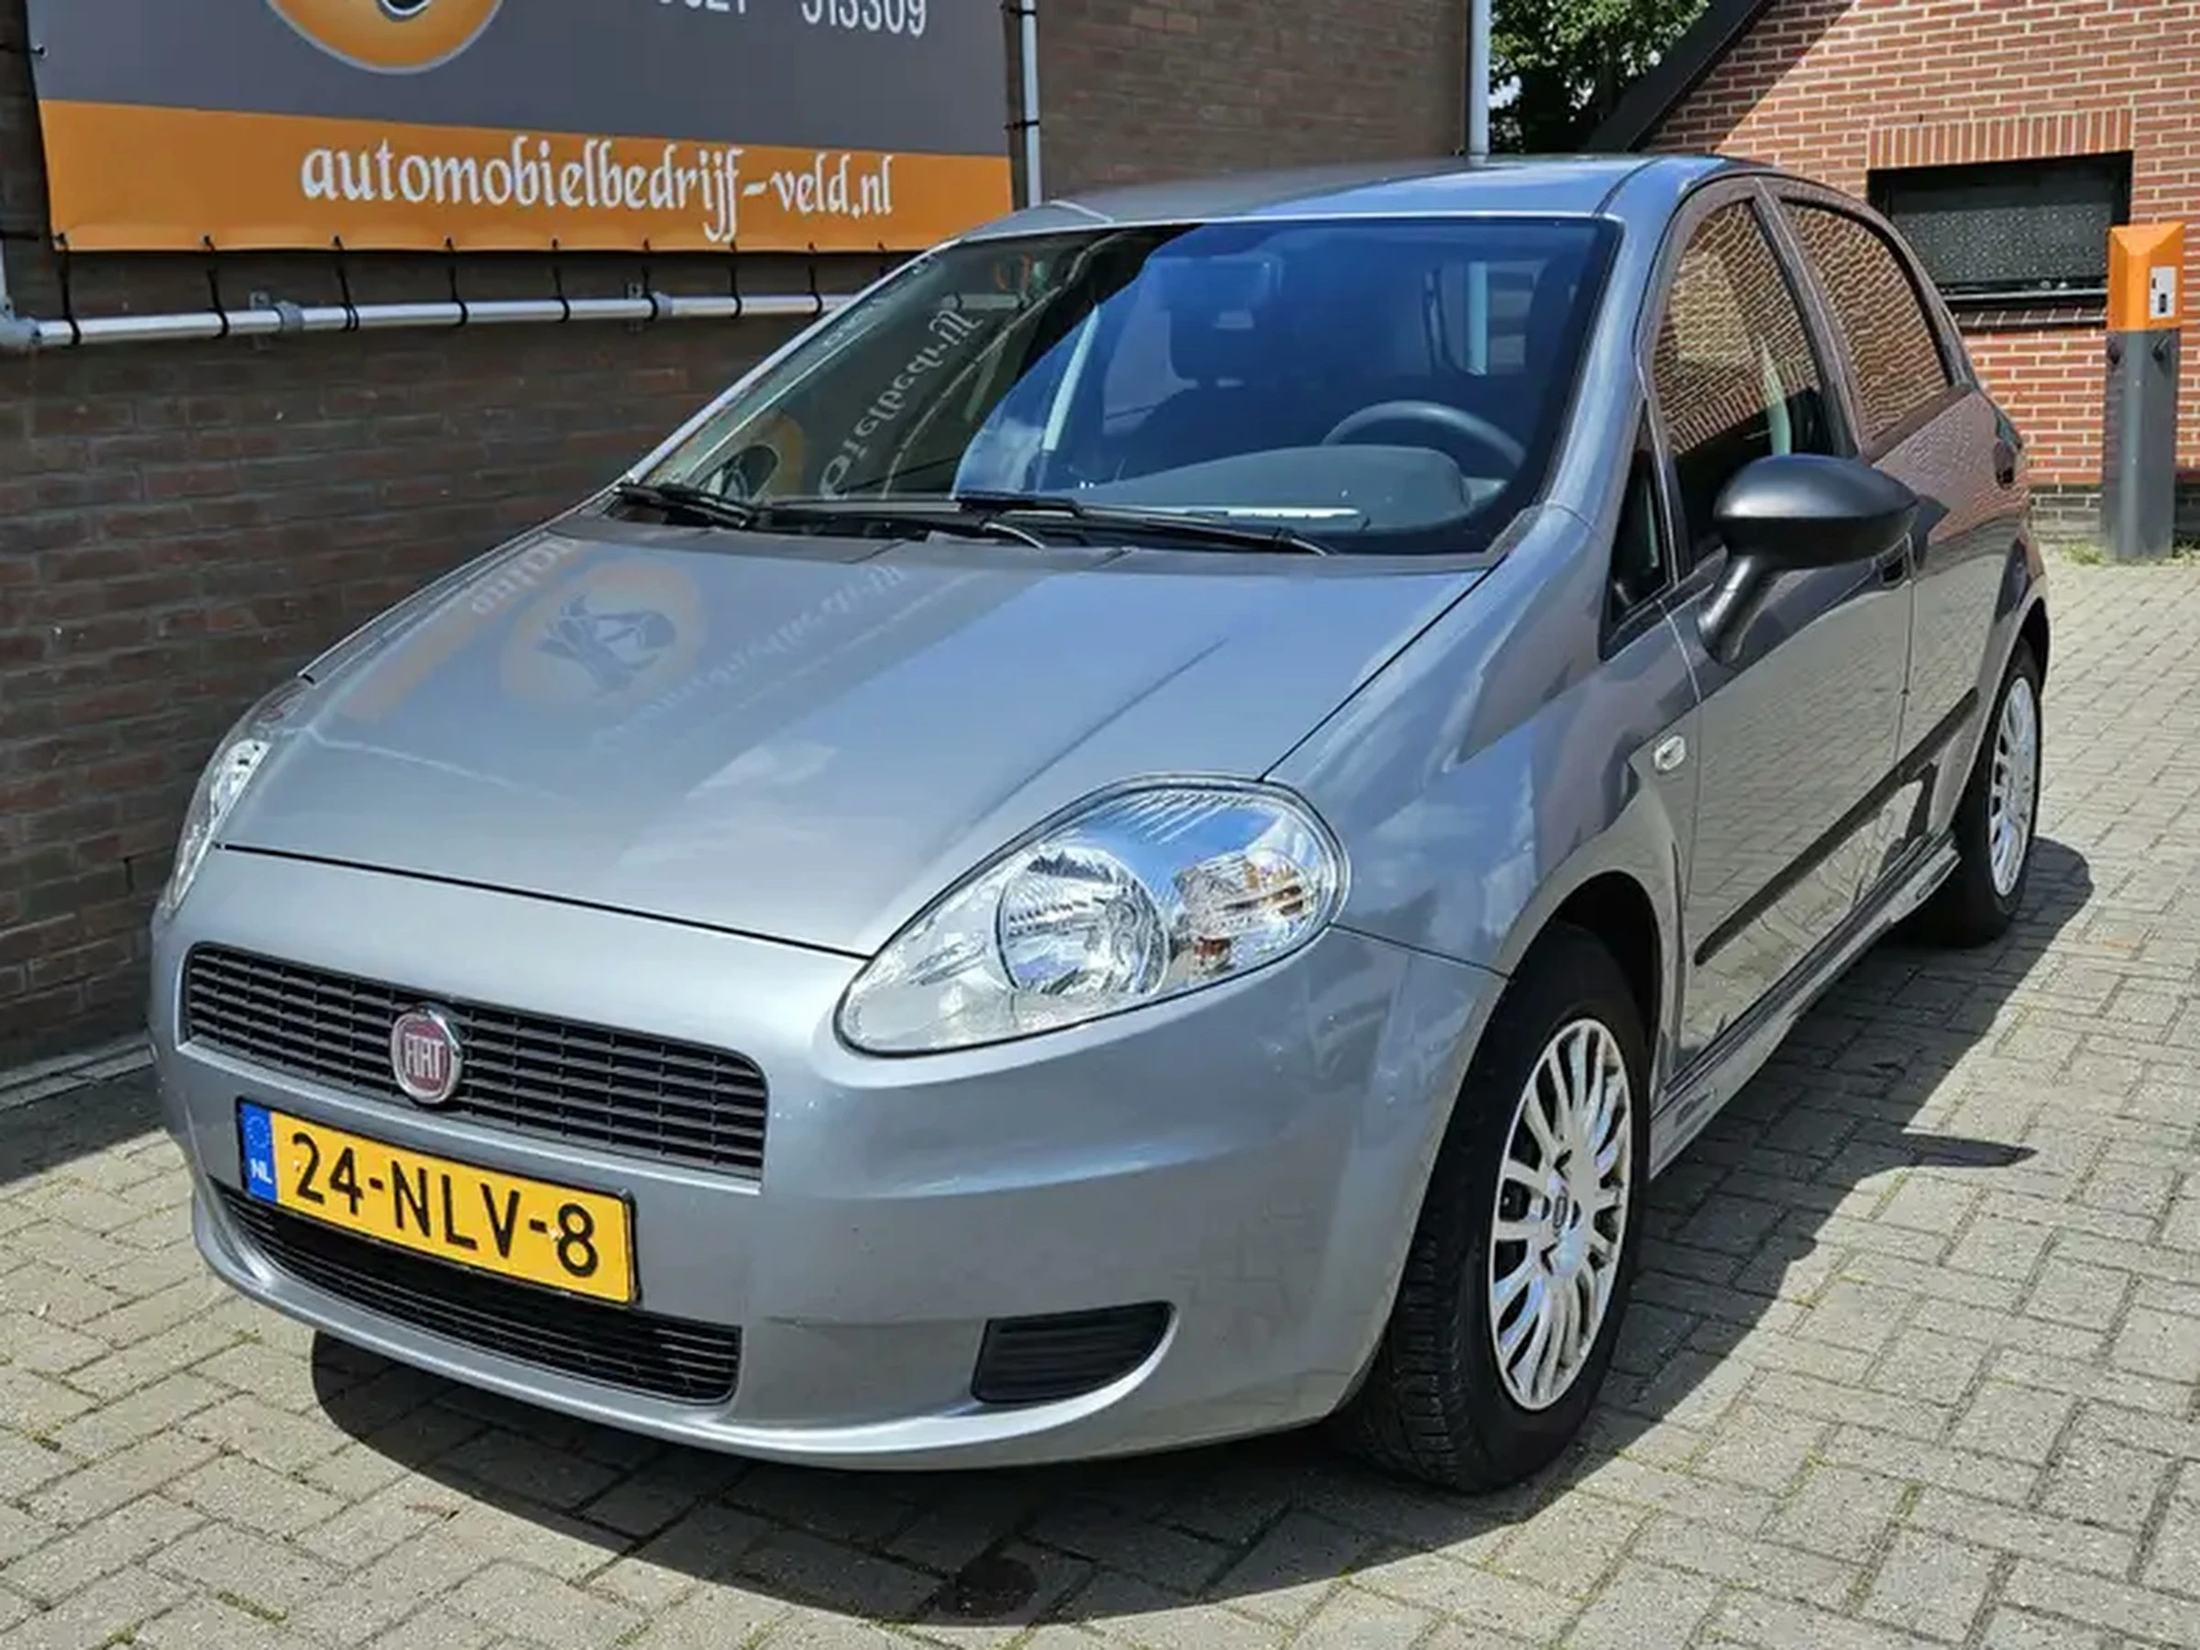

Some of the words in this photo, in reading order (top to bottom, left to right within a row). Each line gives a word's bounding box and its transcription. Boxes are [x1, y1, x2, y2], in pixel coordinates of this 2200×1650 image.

[301, 134, 893, 242] automobielbedrijf-veld.nl
[404, 1032, 444, 1079] FIAT
[250, 1157, 273, 1184] NL
[292, 1132, 599, 1278] 24-NLV-8
